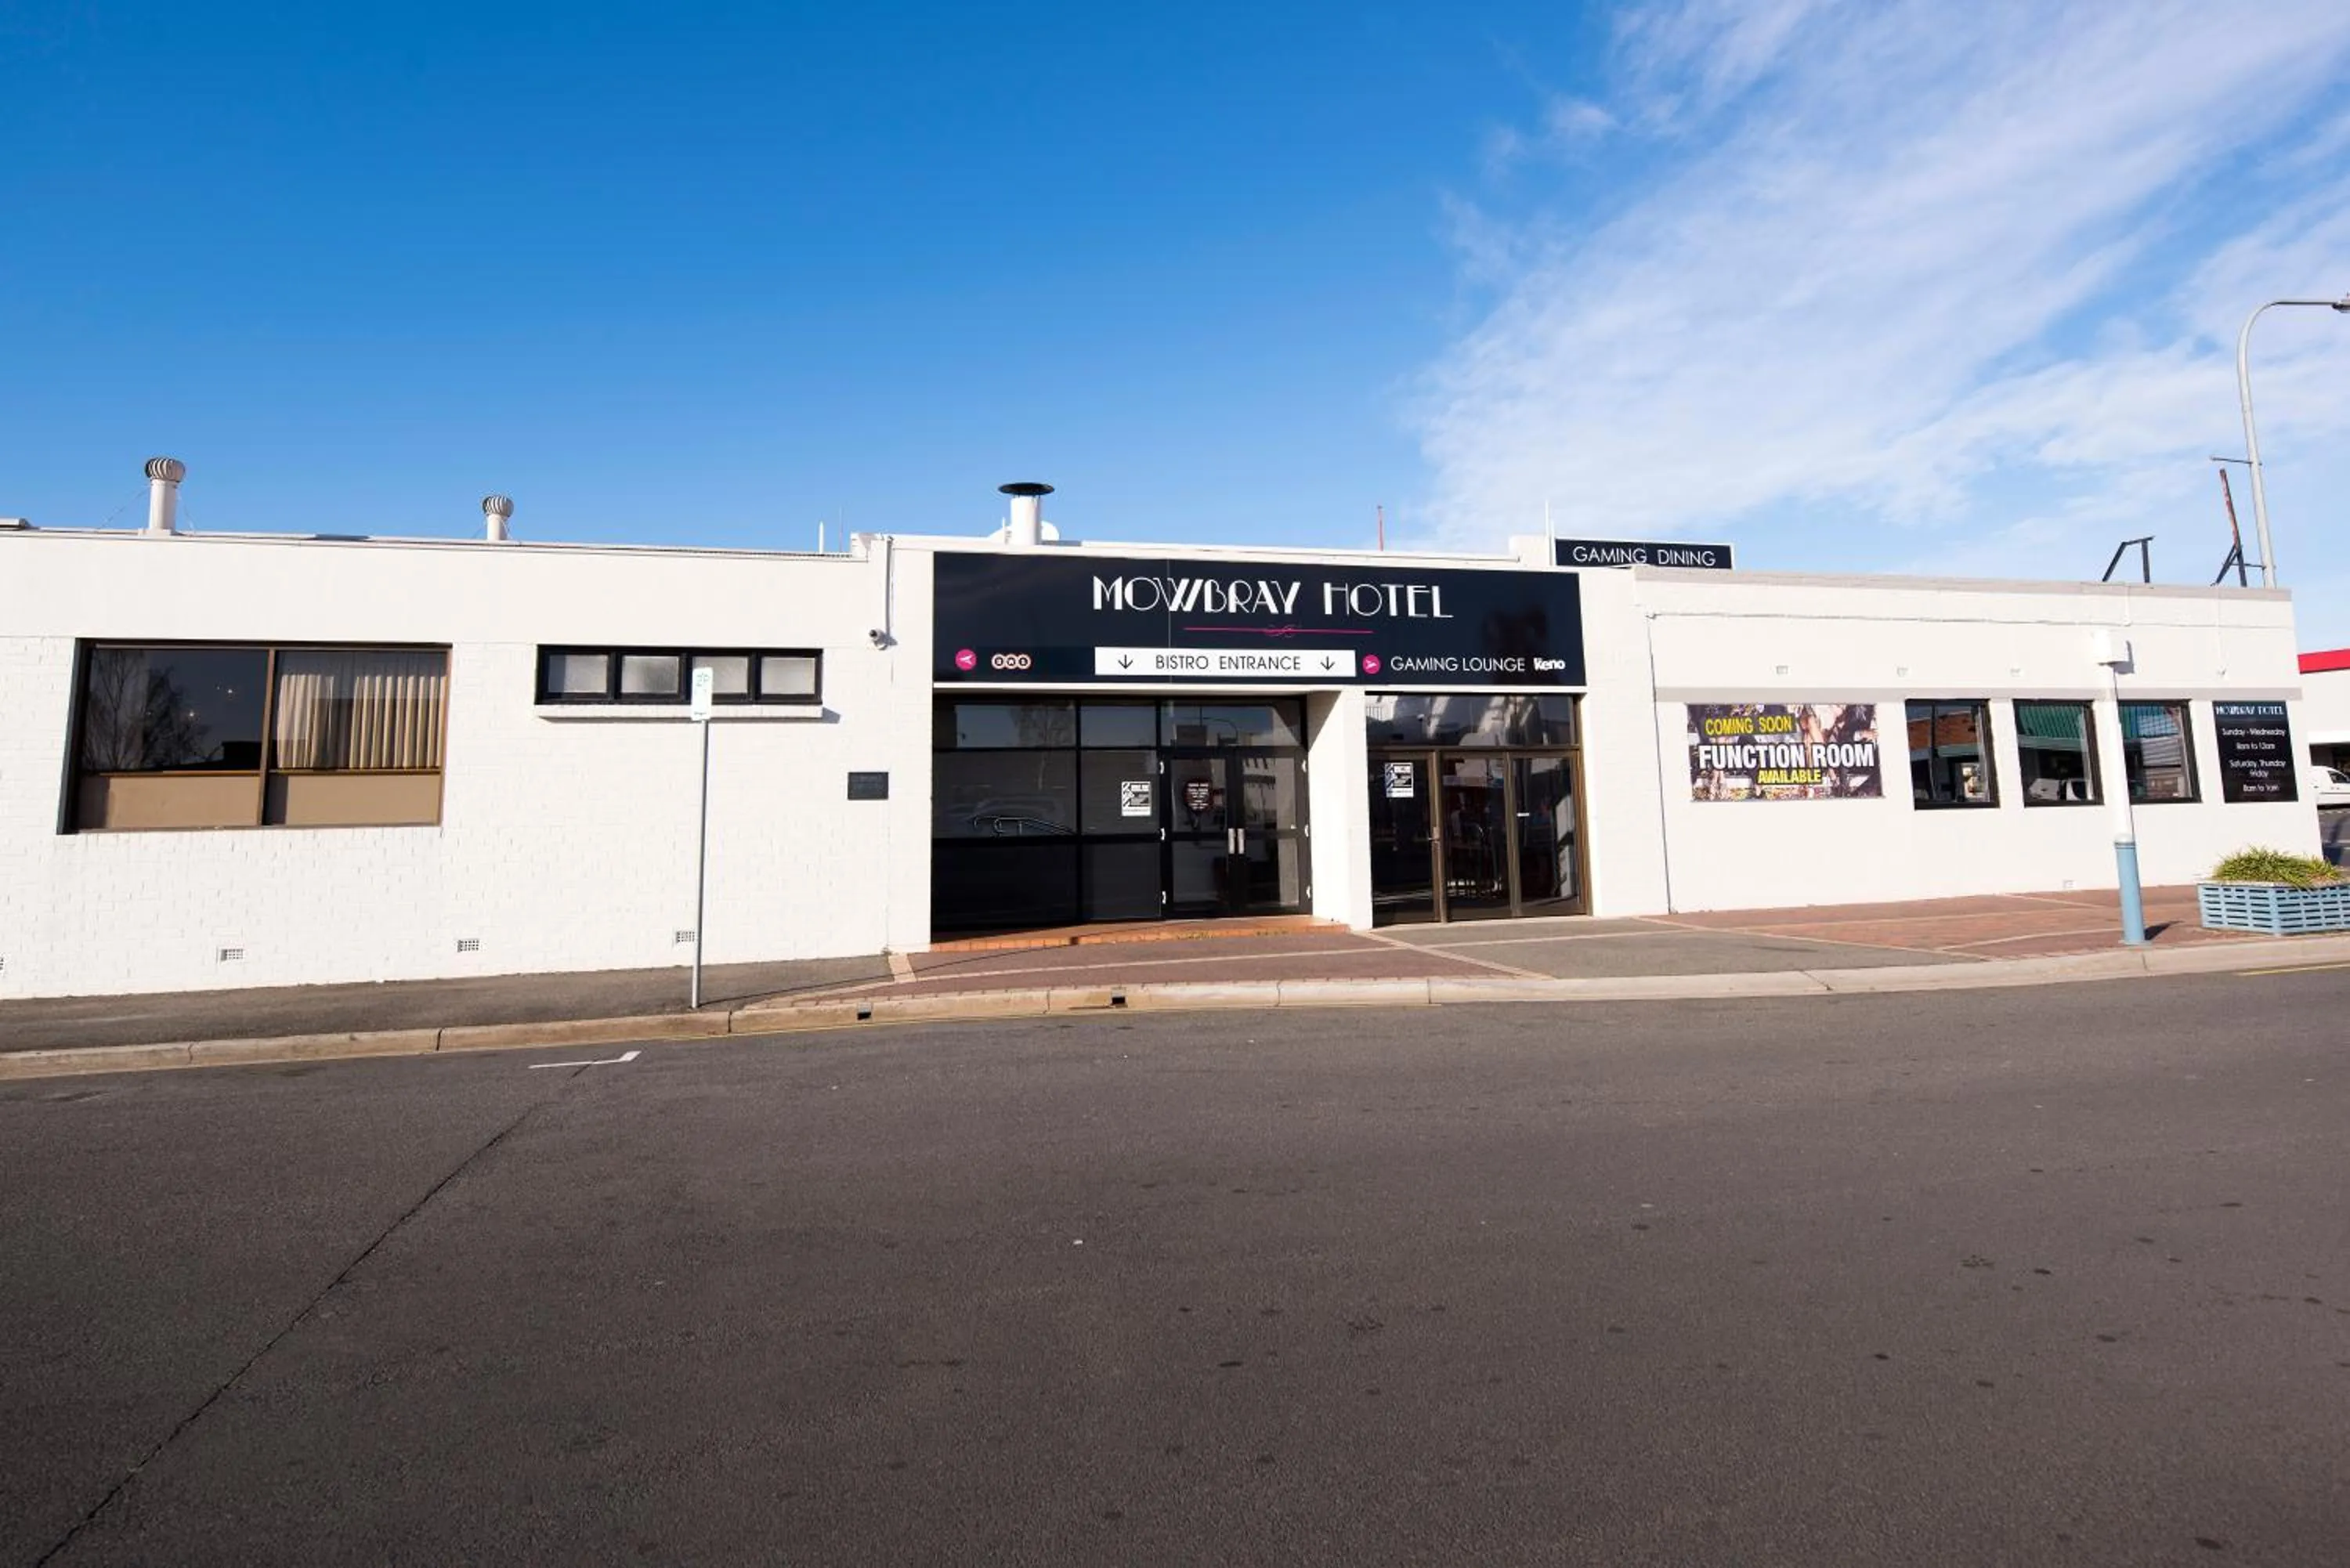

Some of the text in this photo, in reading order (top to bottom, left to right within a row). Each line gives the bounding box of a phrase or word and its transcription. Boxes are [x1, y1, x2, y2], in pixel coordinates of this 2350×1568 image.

[1573, 546, 1716, 566] GAMING DINING
[1093, 576, 1455, 618] MOWBRAY HOTEL
[1155, 655, 1301, 670] BISTRO ENTRANCE
[1390, 656, 1525, 672] GAMING LOUNGE
[1705, 716, 1792, 735] COMING SOON
[2222, 728, 2245, 736] Sunday
[2249, 728, 2286, 736] Wednesday
[1699, 742, 1875, 769] FUNCTION ROOM
[1757, 769, 1823, 783] AVAILABLE
